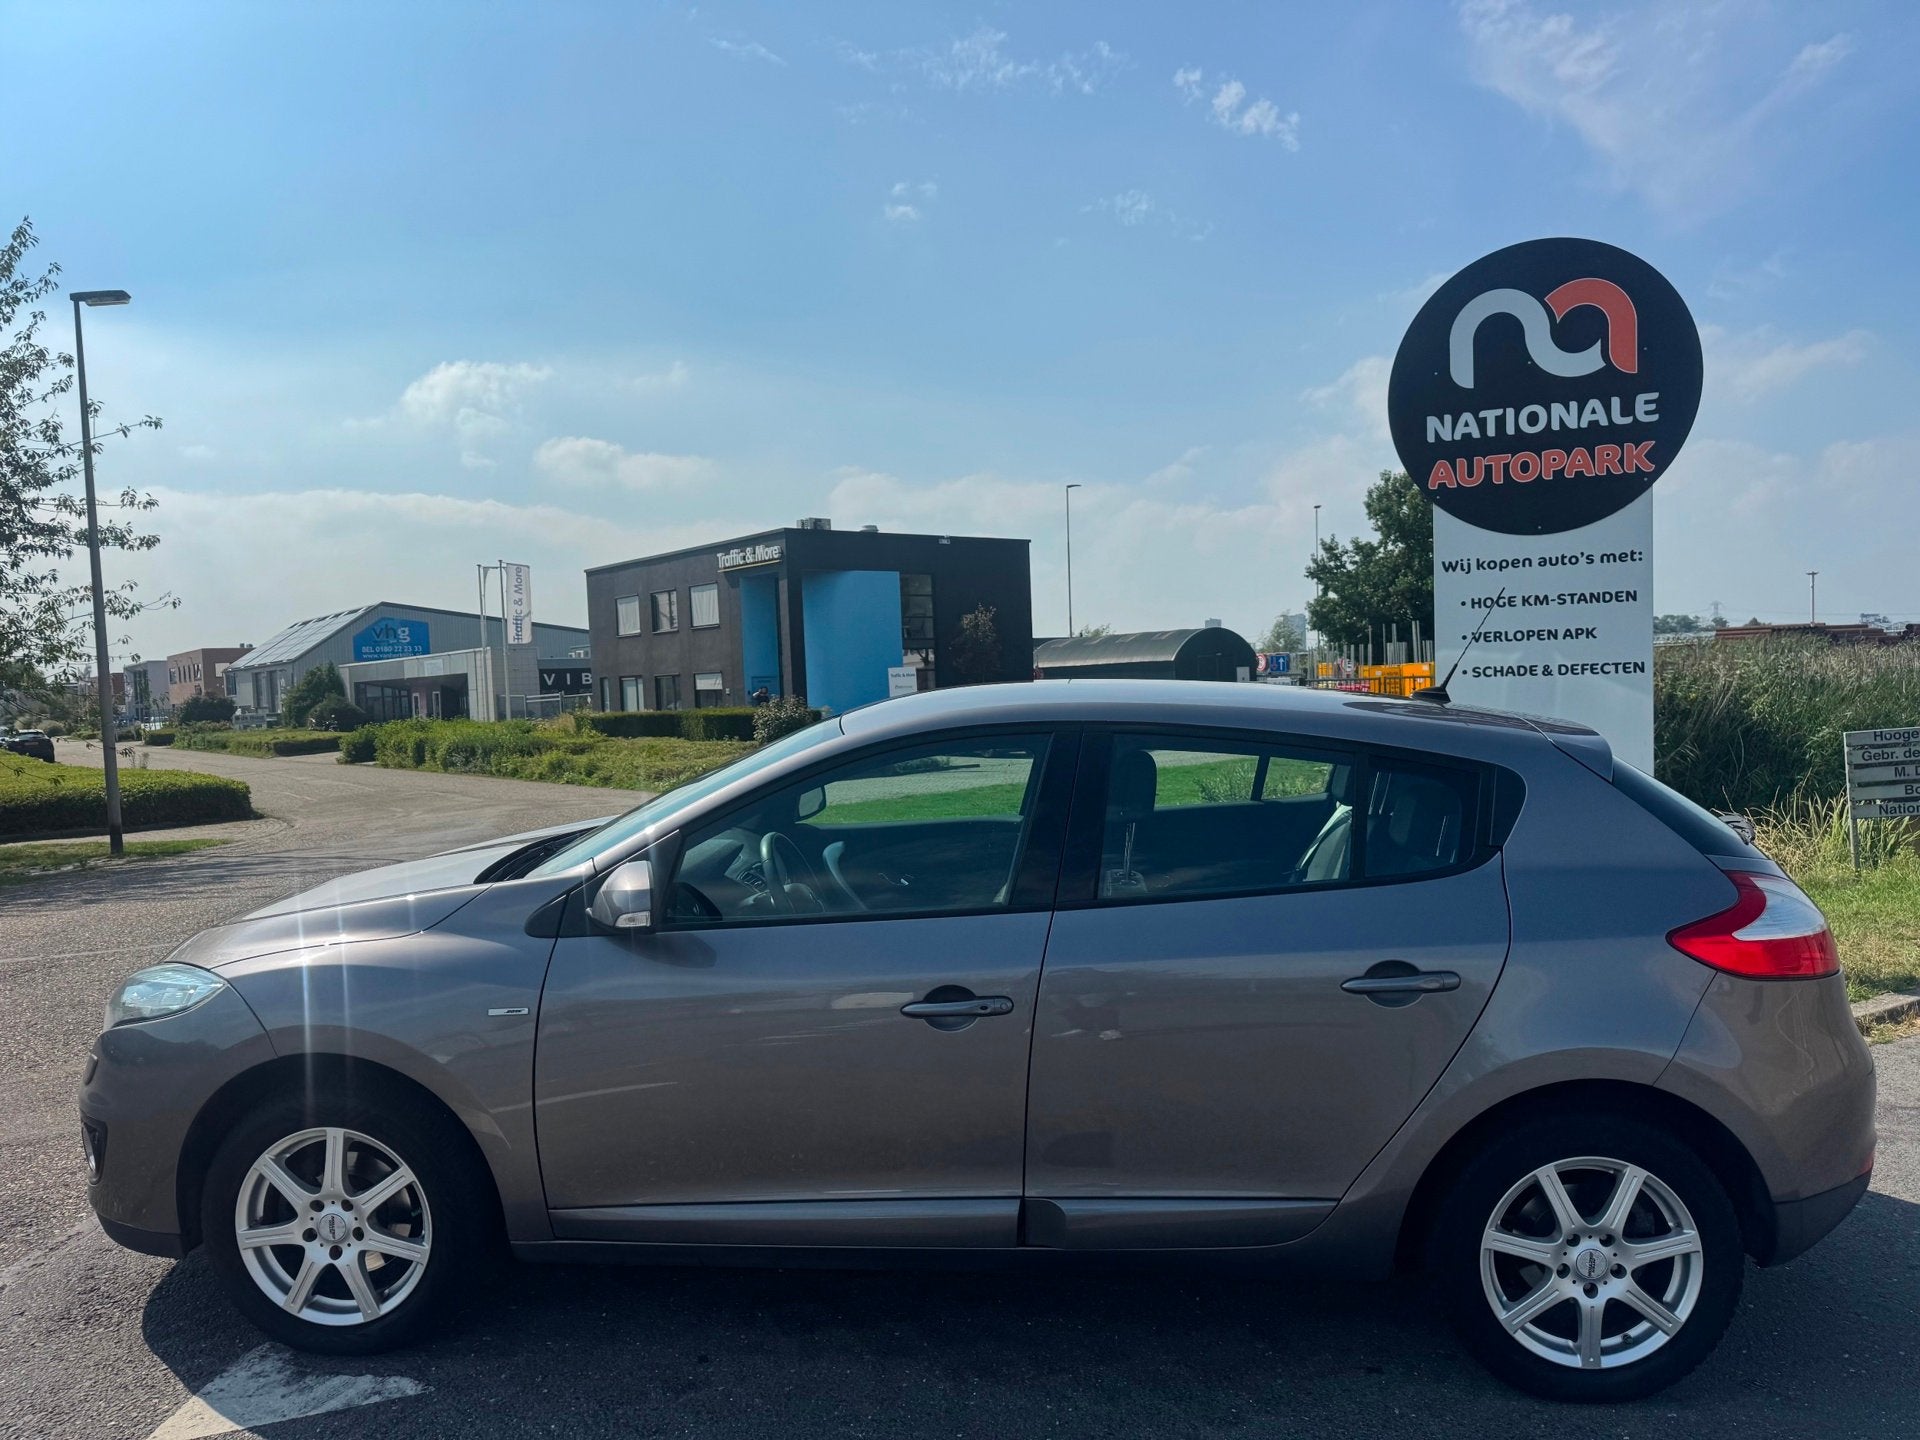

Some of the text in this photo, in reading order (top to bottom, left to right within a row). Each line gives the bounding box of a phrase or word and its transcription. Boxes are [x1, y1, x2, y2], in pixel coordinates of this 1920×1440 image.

[1426, 392, 1660, 443] NATIONALE
[1428, 441, 1656, 489] AUTOPARK
[717, 544, 782, 569] Traffic & More
[1441, 549, 1643, 574] Wij kopen auto's met:
[512, 566, 523, 642] Traffic & More
[1471, 590, 1638, 609] HOGE KM-STANDEN
[372, 623, 411, 643] vhg
[1471, 627, 1598, 643] VERLOPEN APK
[1472, 661, 1646, 678] SCHADE & DEFECTEN
[1873, 730, 1920, 742] Hooge
[1861, 747, 1920, 761] Gebr. de
[1894, 766, 1910, 777] M.
